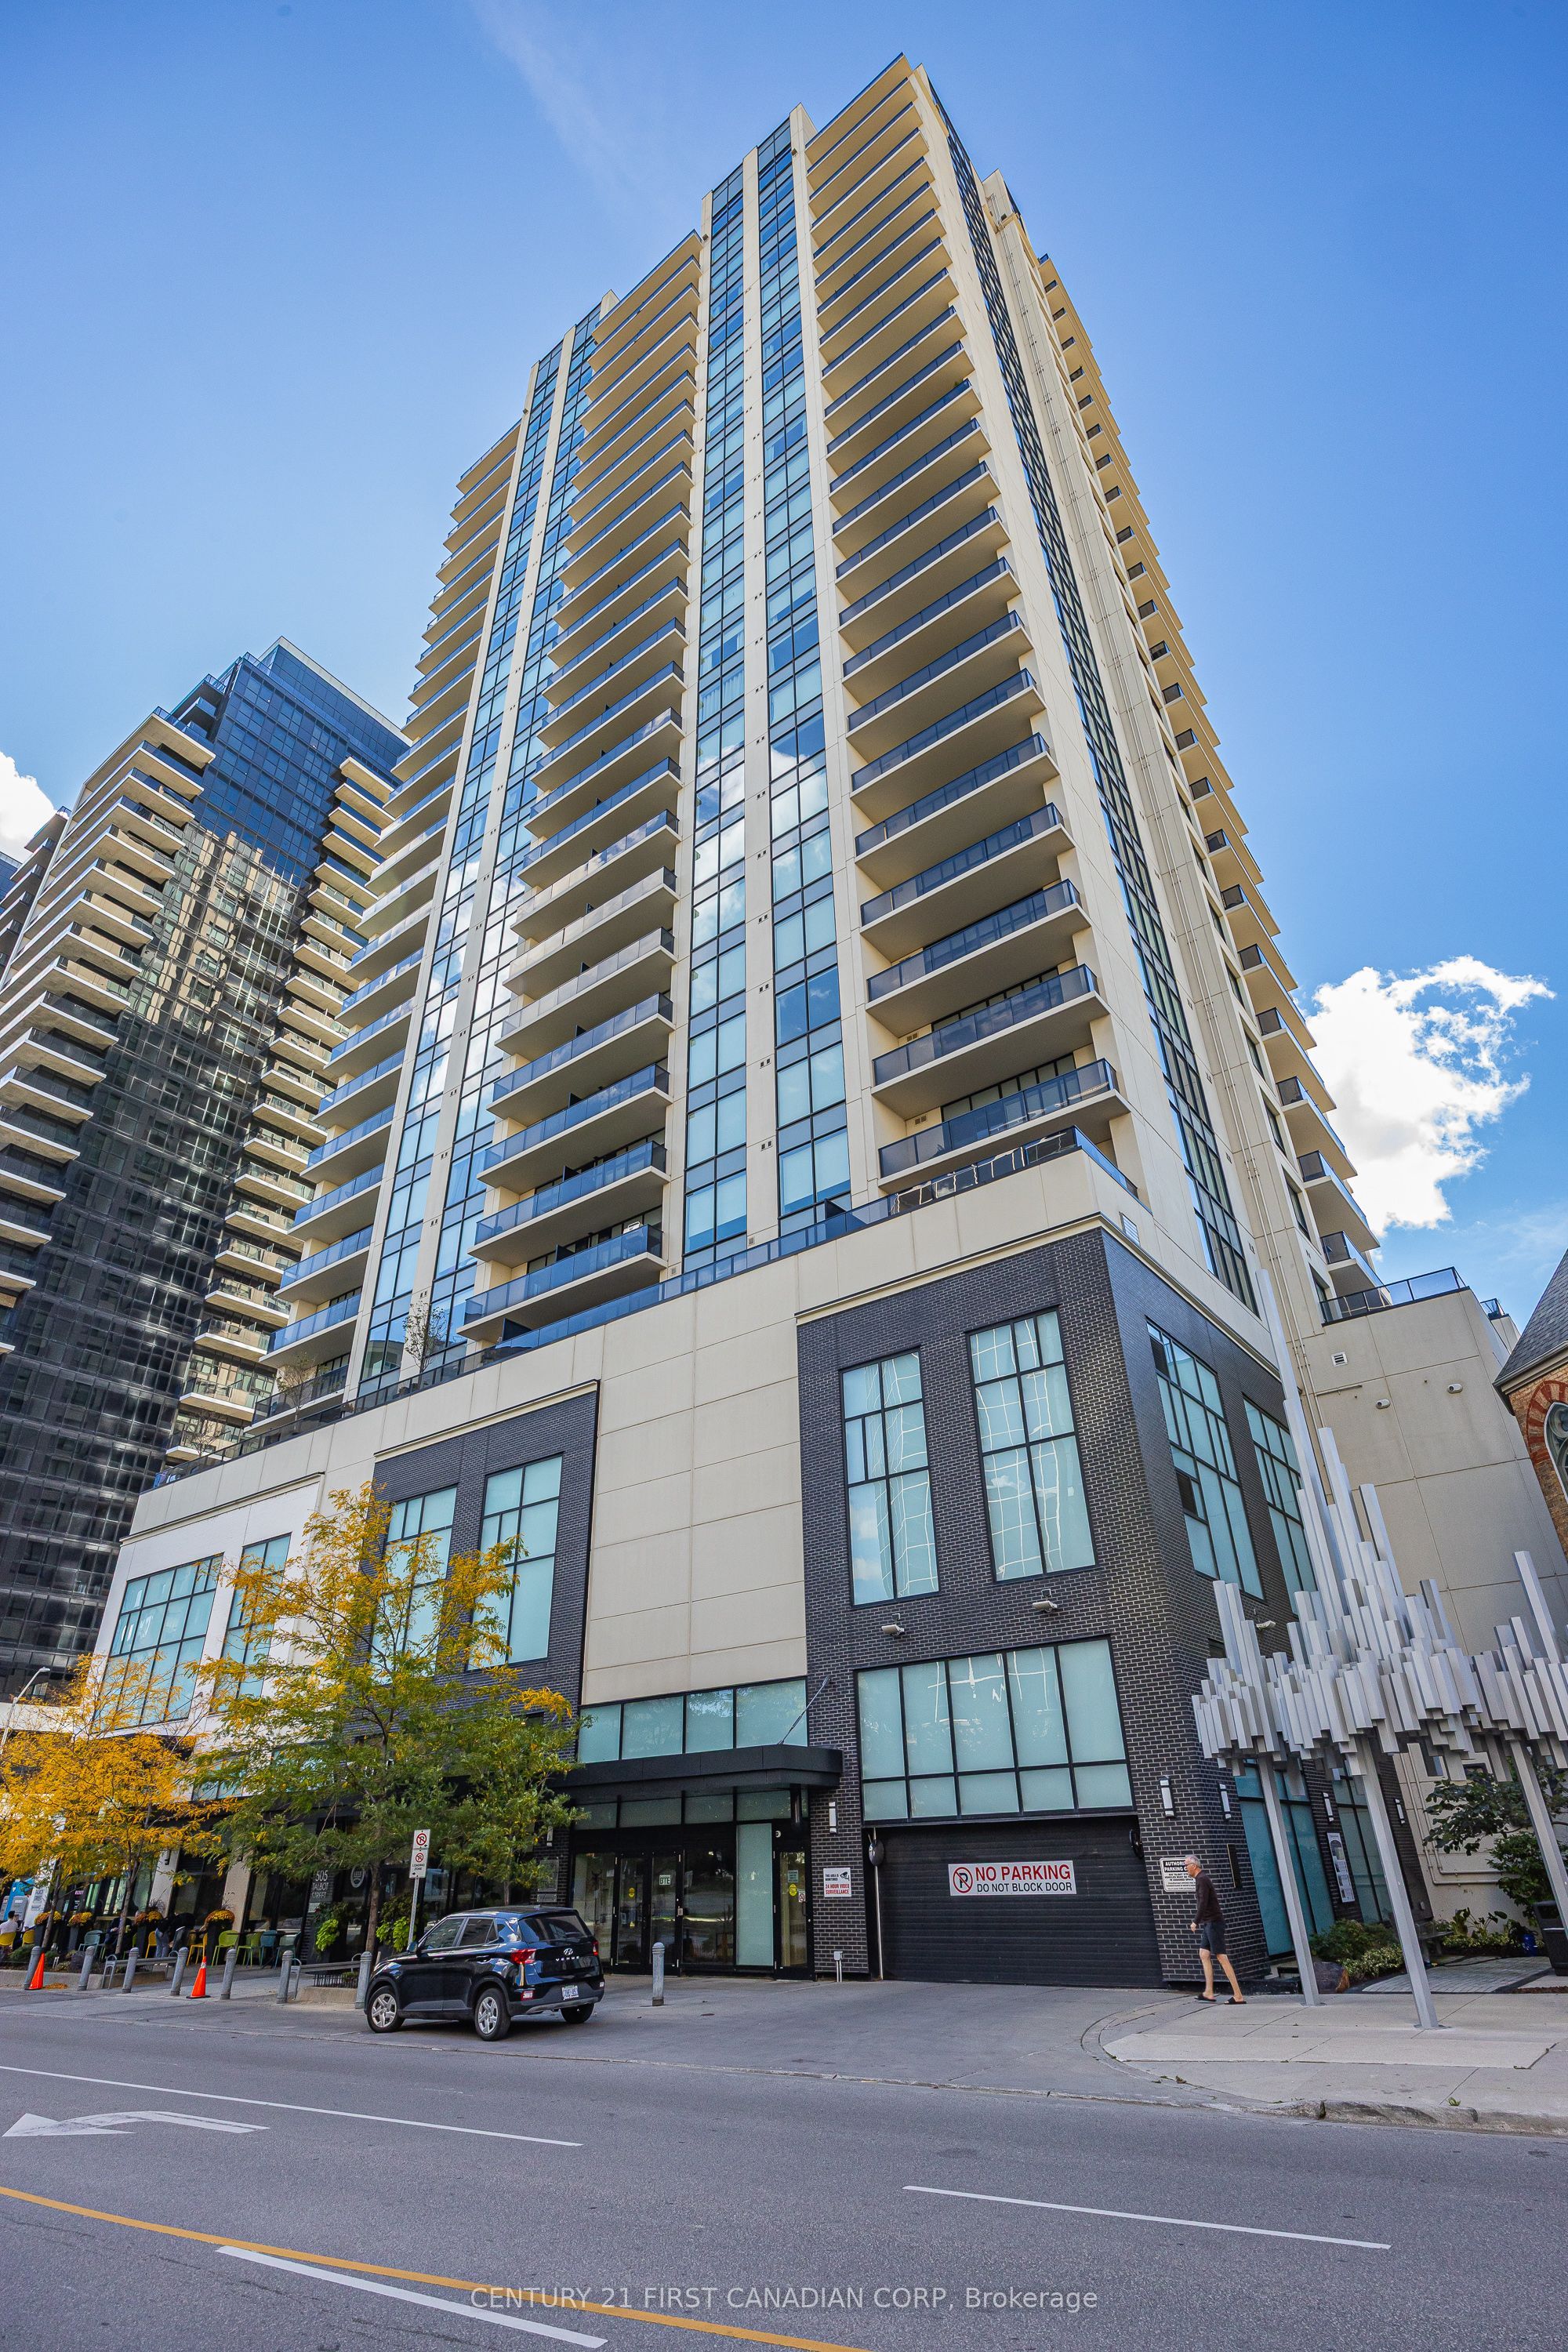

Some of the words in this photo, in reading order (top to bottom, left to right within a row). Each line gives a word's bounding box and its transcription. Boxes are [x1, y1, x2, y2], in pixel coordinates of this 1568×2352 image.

[315, 1870, 328, 1882] 505
[975, 1866, 996, 1881] NO
[1001, 1864, 1071, 1880] PARKING
[312, 1882, 328, 1891] TALBOT
[977, 1883, 989, 1893] DO
[992, 1883, 1010, 1892] NOT
[1012, 1882, 1043, 1892] BLOCK
[1046, 1882, 1073, 1891] DOOR
